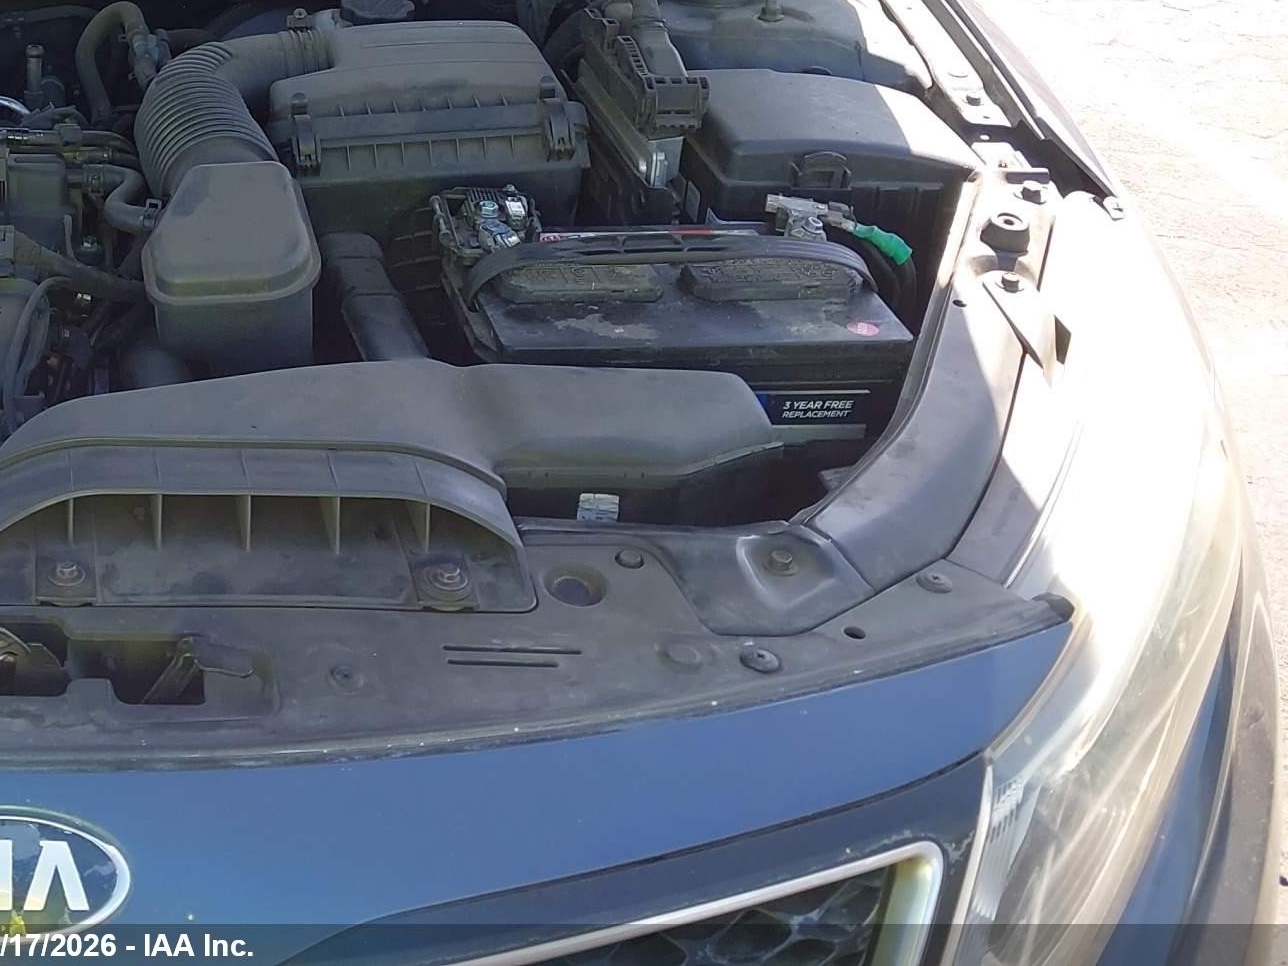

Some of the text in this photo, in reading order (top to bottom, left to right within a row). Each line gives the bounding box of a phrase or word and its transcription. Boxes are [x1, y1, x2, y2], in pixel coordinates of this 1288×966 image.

[783, 400, 854, 410] 3 YEAR FREE
[781, 410, 852, 419] REPLACEMENT
